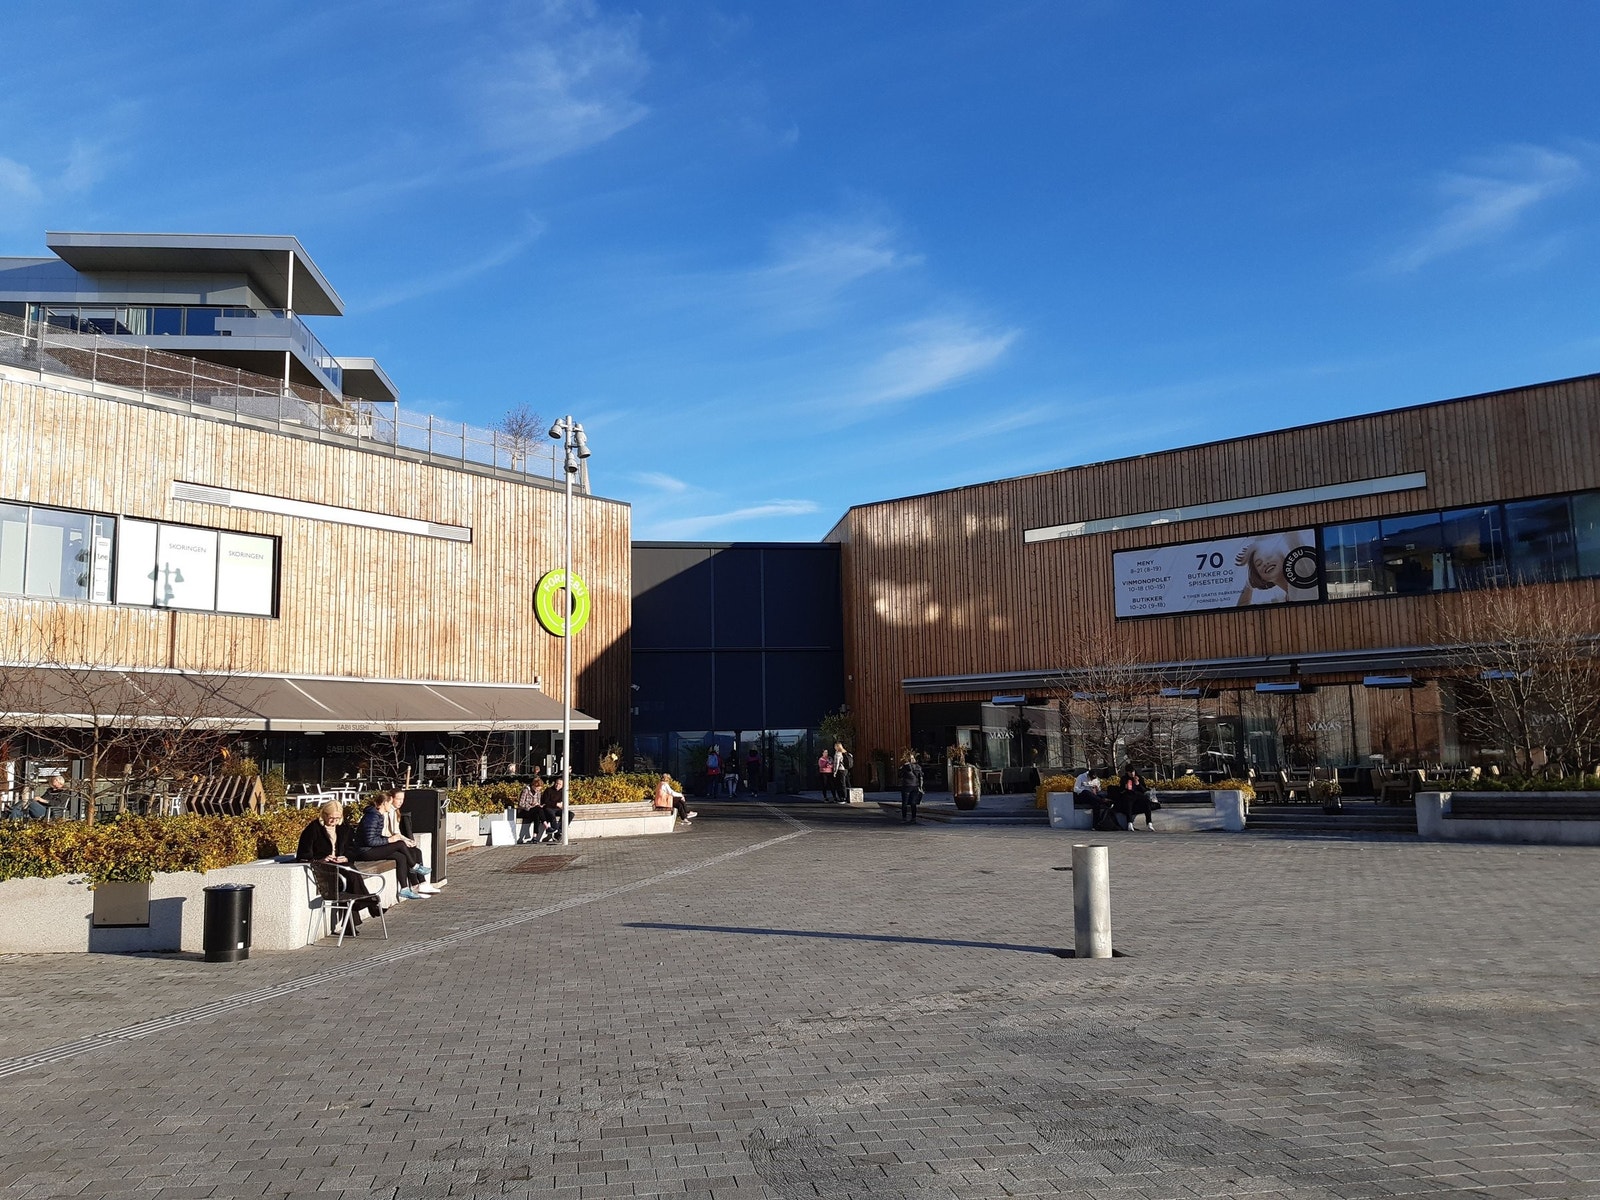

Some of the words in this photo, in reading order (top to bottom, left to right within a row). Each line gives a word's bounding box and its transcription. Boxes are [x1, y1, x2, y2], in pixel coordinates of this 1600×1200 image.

[1196, 552, 1224, 570] 70
[1285, 549, 1304, 582] FORNEBU
[1187, 571, 1221, 579] BUTIKKER
[1121, 576, 1171, 586] VINMONOPOLET
[1188, 576, 1234, 587] SPISESTEDER
[1132, 595, 1163, 603] BUTIKKER
[1306, 720, 1342, 731] MAYAS
[989, 730, 1015, 740] MAYAS
